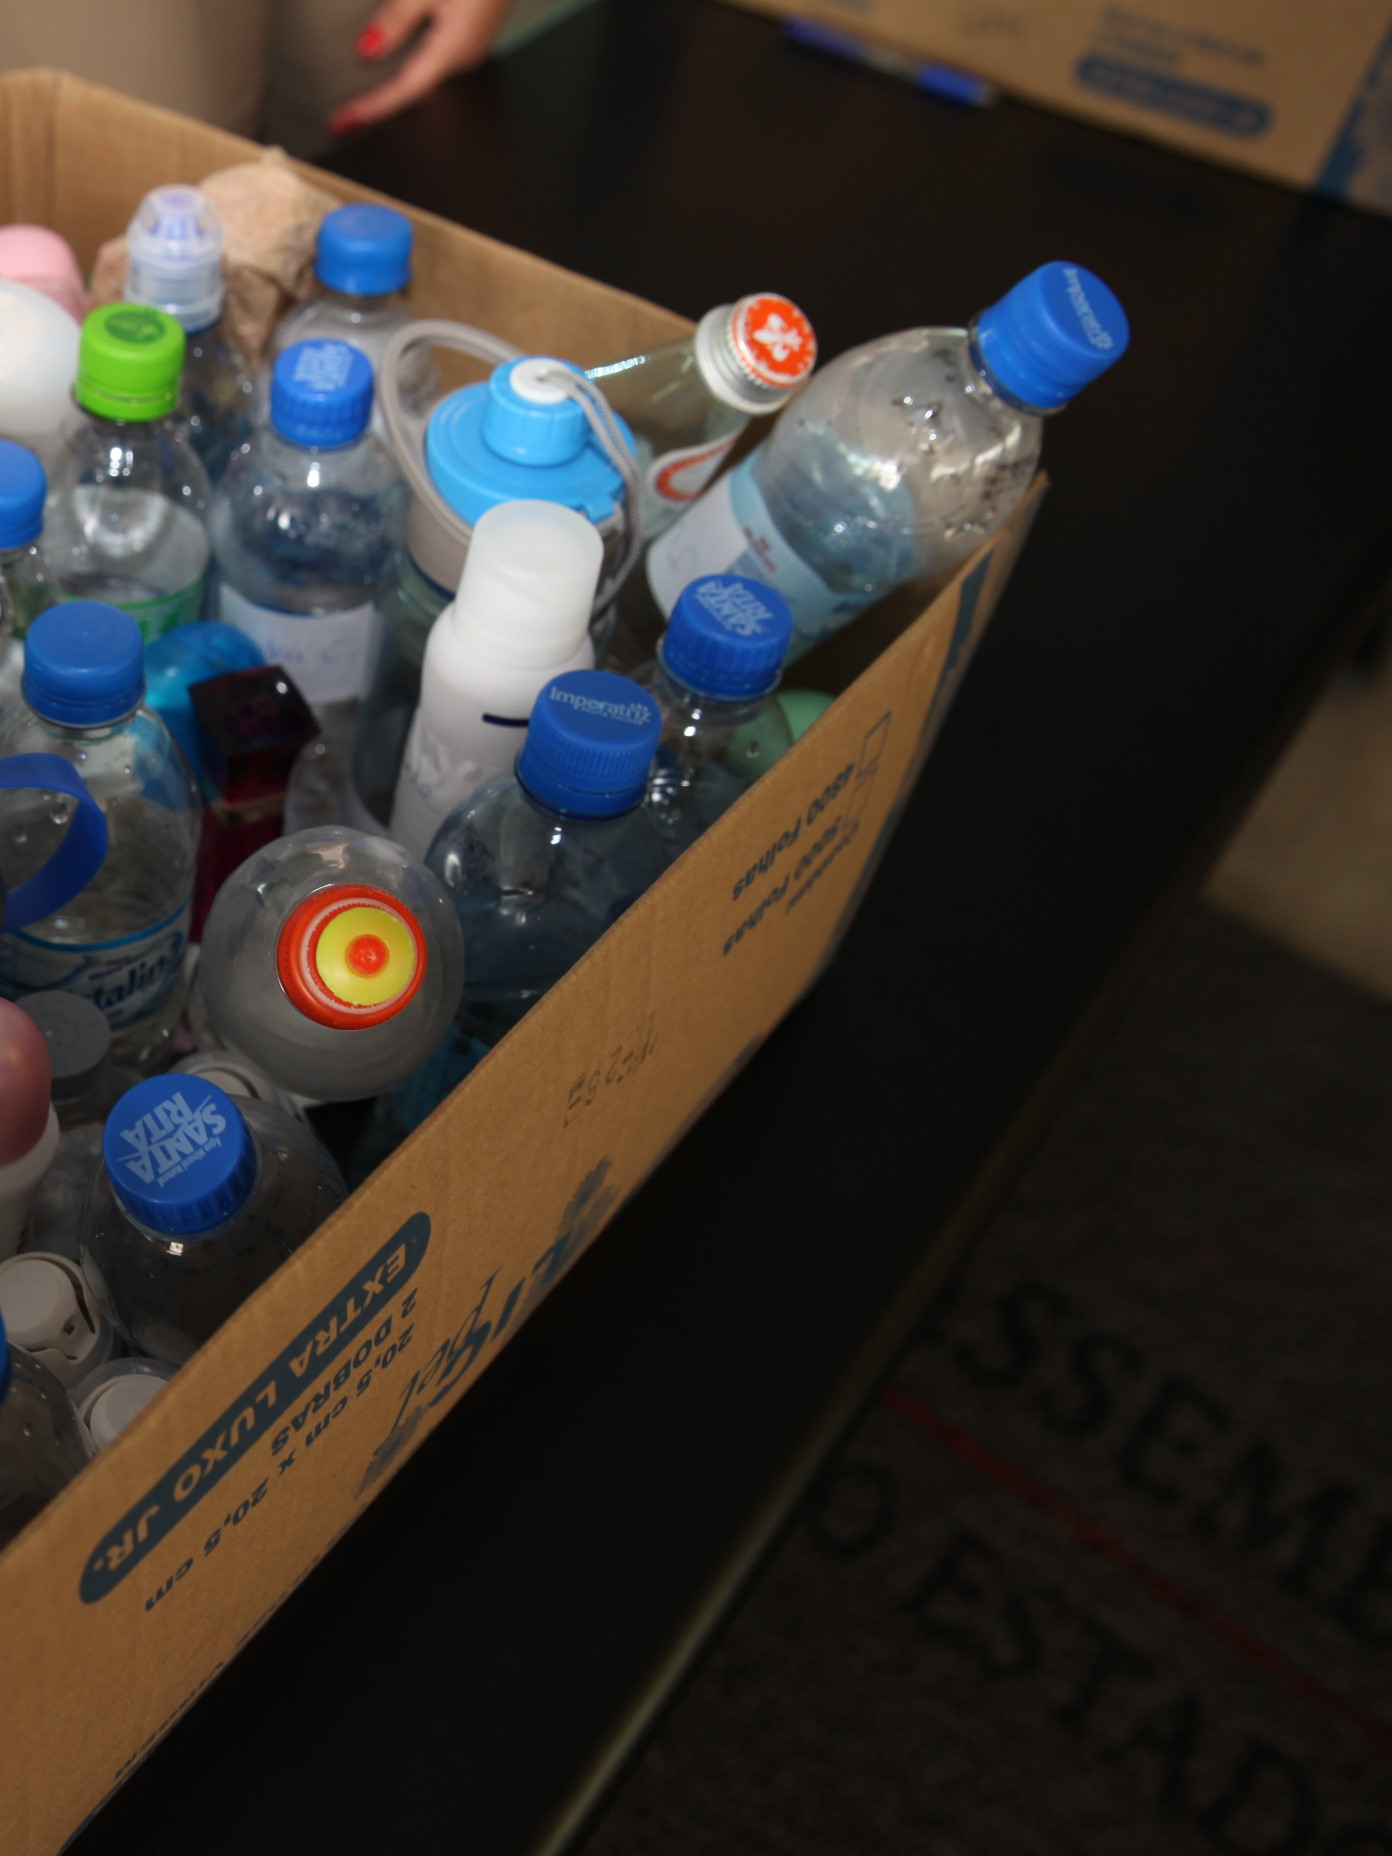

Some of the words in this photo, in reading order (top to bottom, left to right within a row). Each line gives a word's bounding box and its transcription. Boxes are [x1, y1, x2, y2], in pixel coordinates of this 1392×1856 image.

[549, 686, 651, 724] Imperatriz
[733, 816, 802, 901] Folhas
[120, 1092, 194, 1153] RITA
[125, 1103, 226, 1185] SANTA
[288, 1243, 406, 1378] EXTRA
[401, 1287, 418, 1319] 2
[271, 1315, 392, 1456] DOBRAS
[356, 1322, 415, 1397] 20,5
[172, 1379, 277, 1502] LUXO
[305, 1396, 348, 1446] cm
[278, 1449, 297, 1477] x
[203, 1477, 270, 1557] 20,5
[145, 1557, 194, 1611] cm
[897, 1527, 1392, 1856] ESTAD
